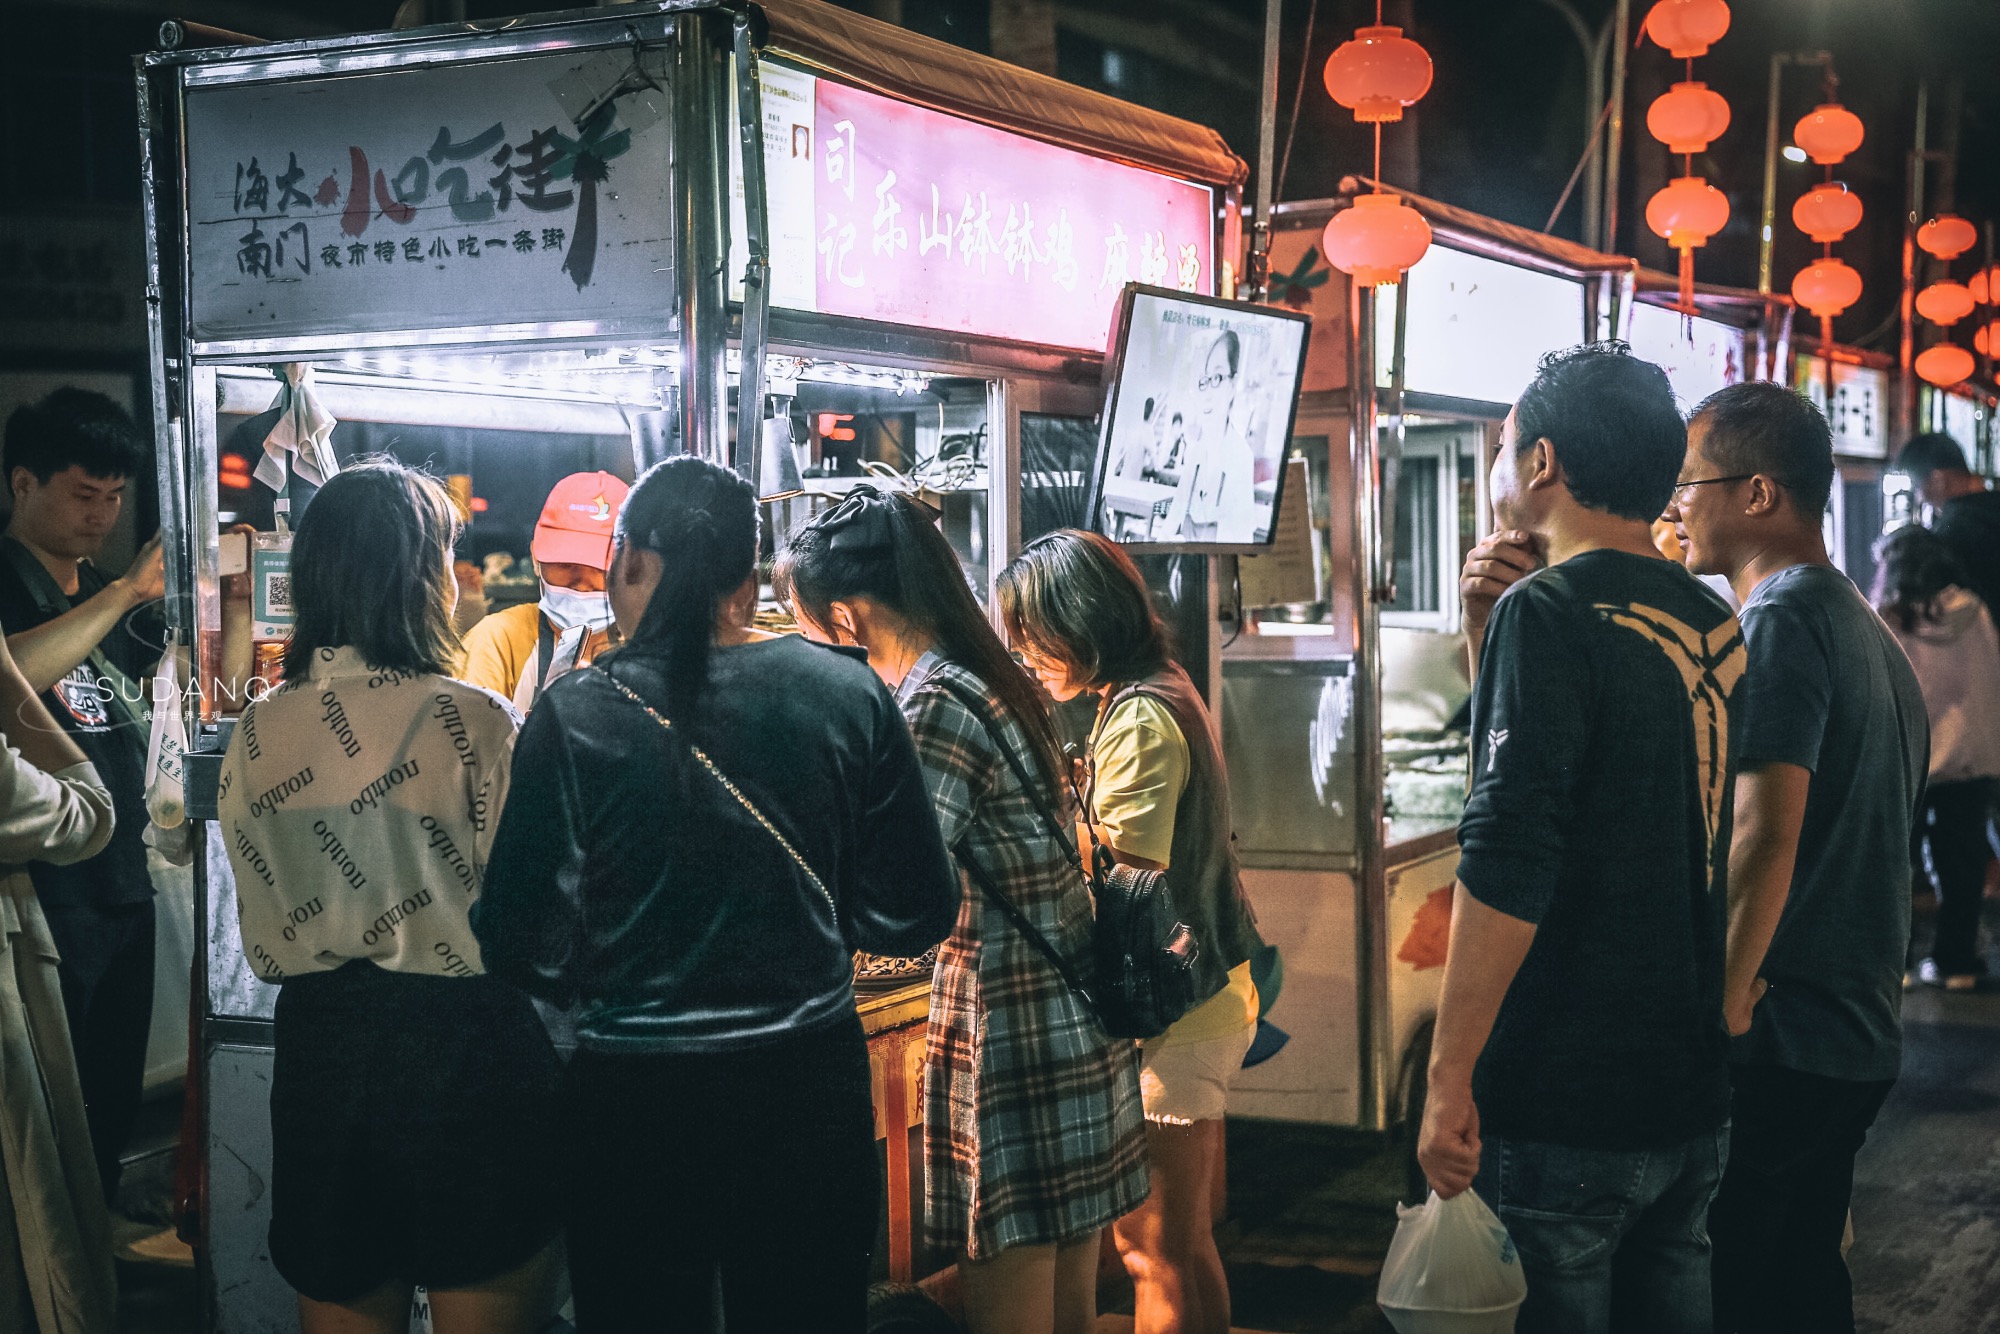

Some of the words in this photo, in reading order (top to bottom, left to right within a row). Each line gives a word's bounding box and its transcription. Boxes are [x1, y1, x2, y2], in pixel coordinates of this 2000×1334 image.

[234, 152, 313, 214] 海大
[313, 112, 606, 252] 小吃街
[817, 119, 865, 288] 司记
[237, 218, 311, 279] 南门
[320, 228, 566, 269] 夜市特色小吃一条街
[872, 169, 1078, 293] 乐山钵钵鸡
